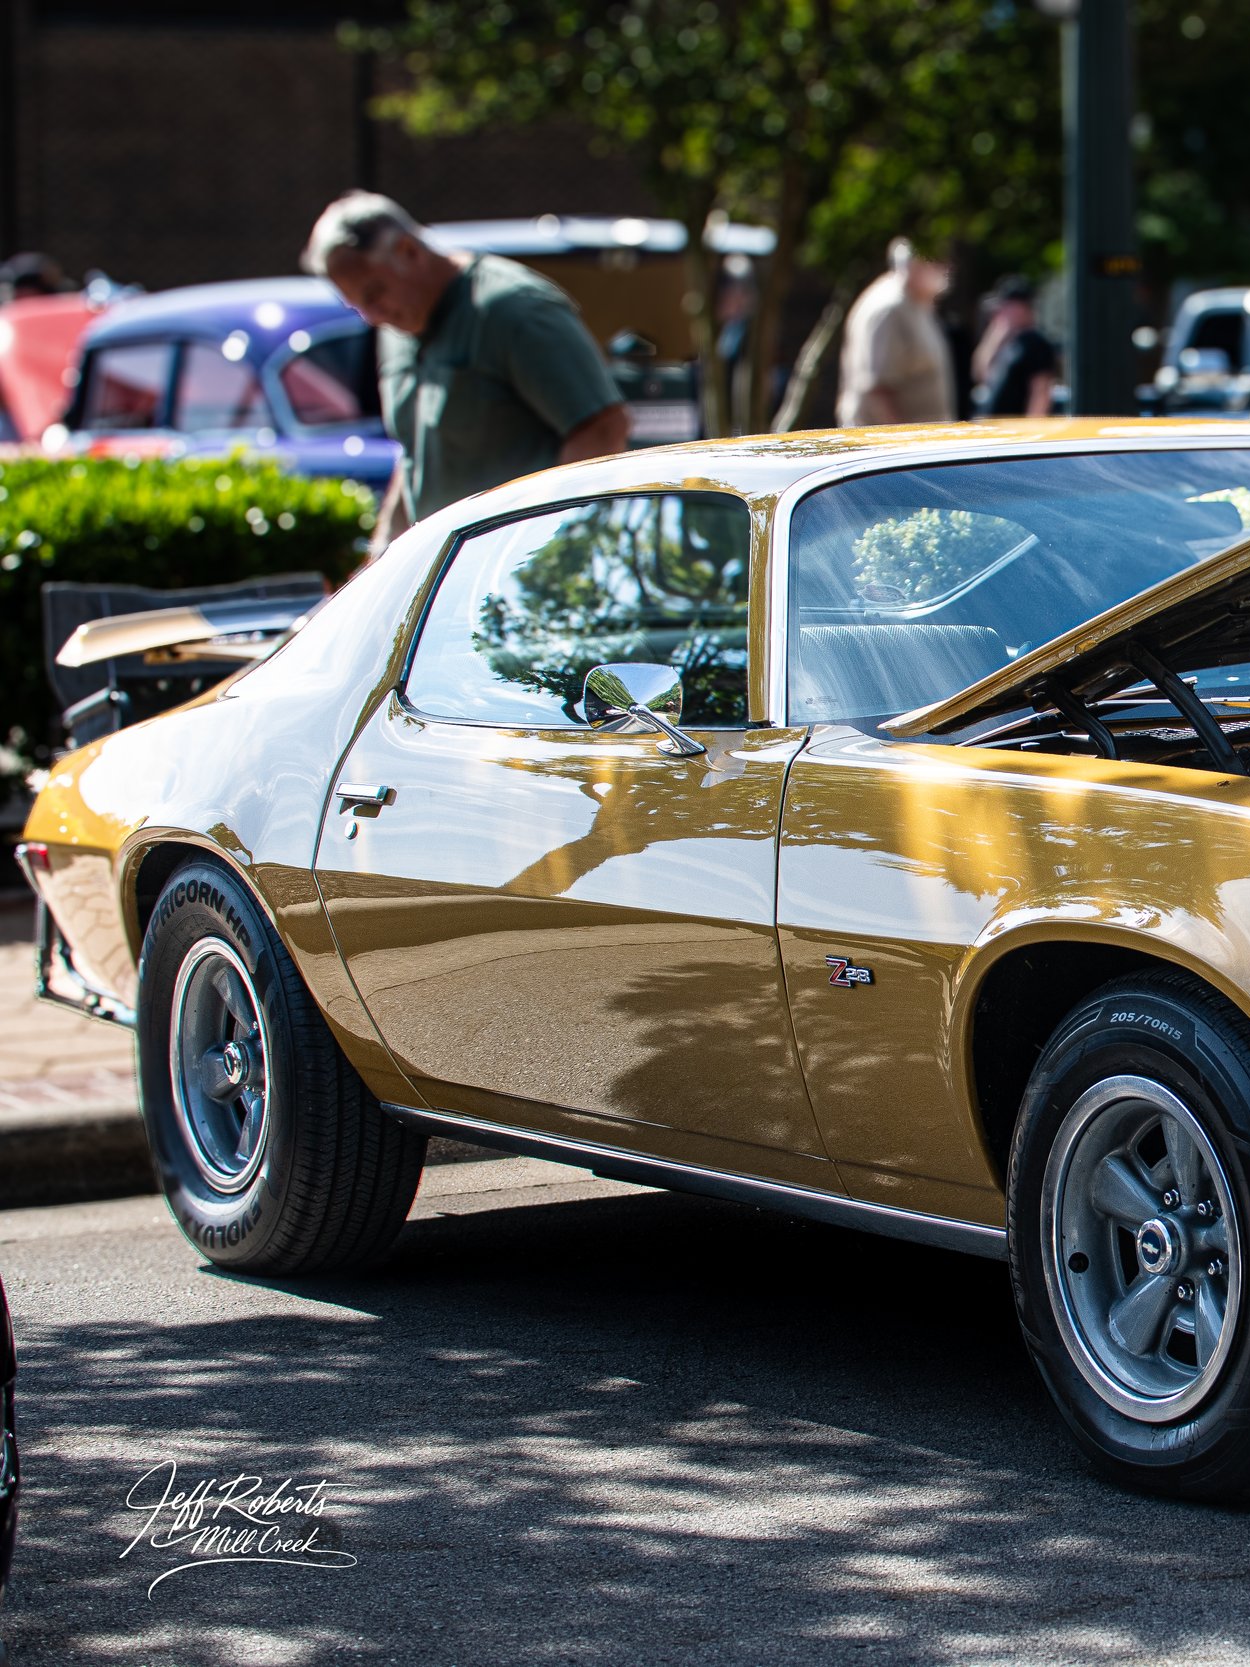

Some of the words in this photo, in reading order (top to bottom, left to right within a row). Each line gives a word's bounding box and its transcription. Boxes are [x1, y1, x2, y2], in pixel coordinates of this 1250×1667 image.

[226, 906, 251, 949] HP
[825, 954, 872, 988] Z28
[1109, 1011, 1183, 1041] 205/70R15
